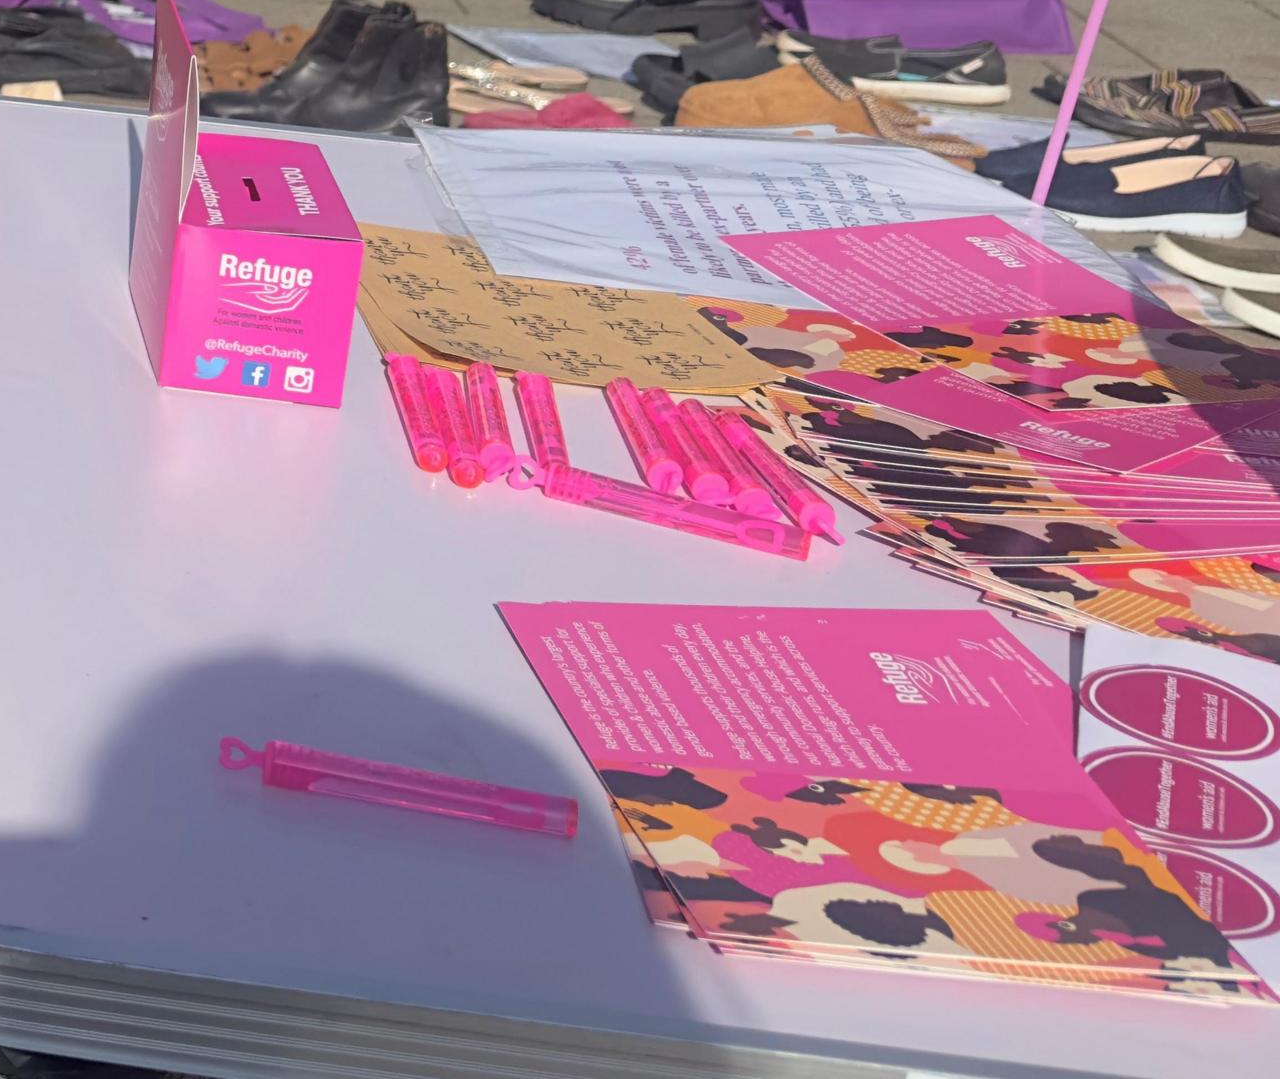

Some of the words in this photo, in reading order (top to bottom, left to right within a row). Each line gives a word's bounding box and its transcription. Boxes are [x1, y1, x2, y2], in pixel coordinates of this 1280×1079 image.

[280, 167, 306, 185] YOU
[195, 178, 222, 208] support
[290, 185, 320, 216] THANK
[207, 209, 224, 225] Your
[965, 236, 1027, 268] Refuge
[219, 253, 313, 289] Refuge
[204, 338, 308, 362] @RefugeCharity
[1020, 420, 1111, 449] Refuge
[555, 627, 569, 639] for
[573, 622, 604, 663] experience
[598, 631, 618, 653] forms
[673, 623, 688, 639] day,
[756, 630, 772, 643] the
[541, 636, 563, 661] largest
[563, 640, 589, 669] support
[683, 640, 703, 661] every
[693, 623, 740, 685] accommodation,
[722, 639, 738, 652] the
[740, 635, 766, 667] Helpline,
[780, 635, 804, 660] across
[599, 664, 616, 681] who
[613, 655, 633, 676] other
[672, 654, 706, 694] thousands
[730, 654, 750, 669] and
[771, 653, 794, 676] which
[558, 663, 586, 697] country's
[583, 671, 612, 706] specialist
[625, 676, 644, 692] and
[643, 669, 670, 701] violence.
[698, 662, 726, 693] children
[746, 671, 774, 703] services,
[763, 669, 786, 693] Abuse
[787, 677, 807, 692] and
[799, 662, 828, 692] services
[869, 651, 928, 705] Refuge
[580, 698, 596, 712] the
[611, 682, 637, 713] children
[638, 693, 661, 717] abuse
[720, 695, 740, 713] their
[737, 687, 773, 729] emergency
[803, 695, 822, 714] runs,
[822, 694, 853, 725] support
[663, 702, 688, 726] based
[702, 696, 731, 730] supports
[733, 714, 753, 730] and
[783, 696, 816, 731] Domestic
[595, 721, 618, 749] Refuge
[613, 718, 644, 752] provider
[638, 720, 663, 753] women
[656, 720, 686, 755] domestic
[771, 706, 808, 749] community
[819, 715, 844, 743] Refuge
[683, 729, 713, 757] gender
[727, 732, 752, 760] Refuge
[748, 732, 775, 762] women
[767, 731, 798, 763] through
[810, 733, 841, 766] National
[840, 744, 865, 768] which
[857, 737, 893, 770] gateway
[803, 751, 821, 765] our
[894, 757, 912, 772] the
